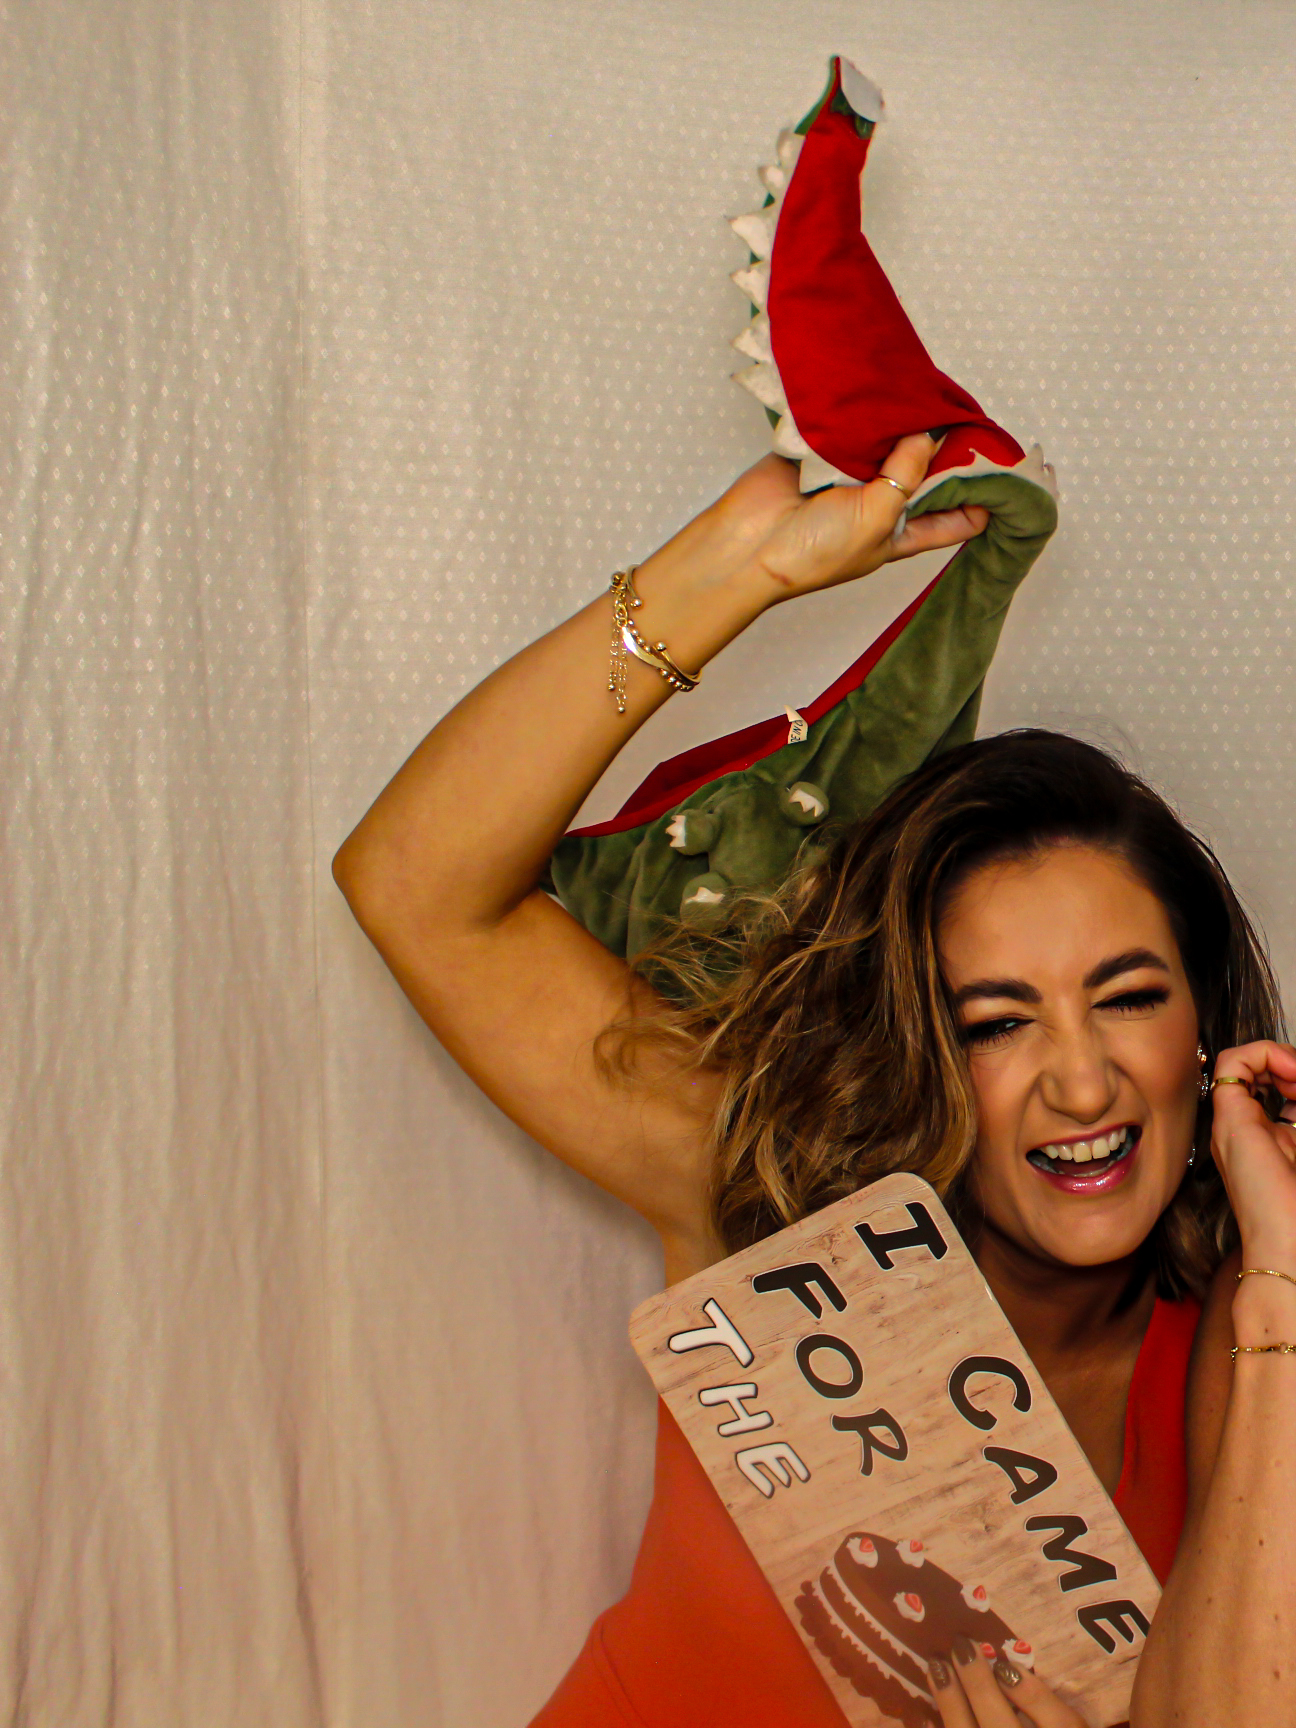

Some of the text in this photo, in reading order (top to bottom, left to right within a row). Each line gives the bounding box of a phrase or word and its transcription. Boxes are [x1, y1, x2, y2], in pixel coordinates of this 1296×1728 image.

[668, 1298, 811, 1498] THE
[753, 1262, 909, 1477] FOR
[853, 1201, 1150, 1654] I CAME
